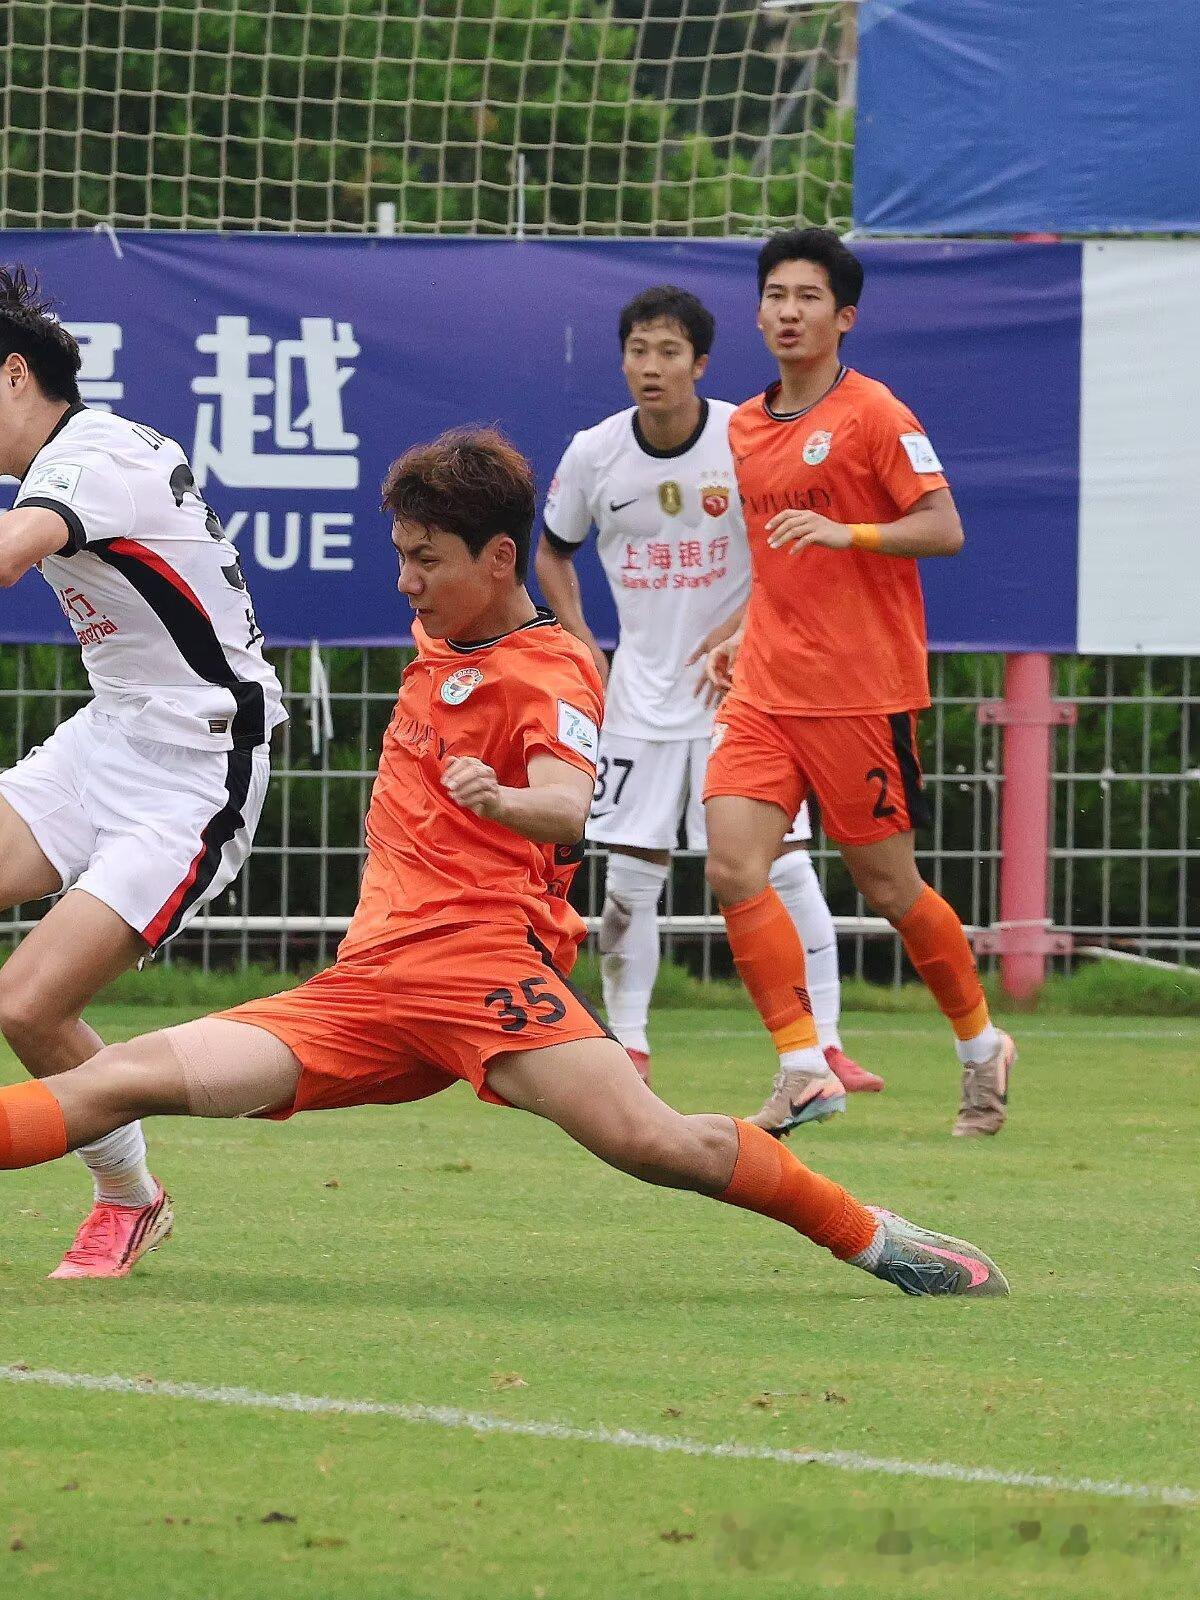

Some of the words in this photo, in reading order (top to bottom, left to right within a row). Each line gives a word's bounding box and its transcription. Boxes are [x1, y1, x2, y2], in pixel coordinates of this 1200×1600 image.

[621, 535, 729, 570] 上海银行
[653, 573, 668, 589] of
[594, 756, 635, 805] 37
[865, 768, 897, 819] 2
[484, 976, 567, 1032] 35
